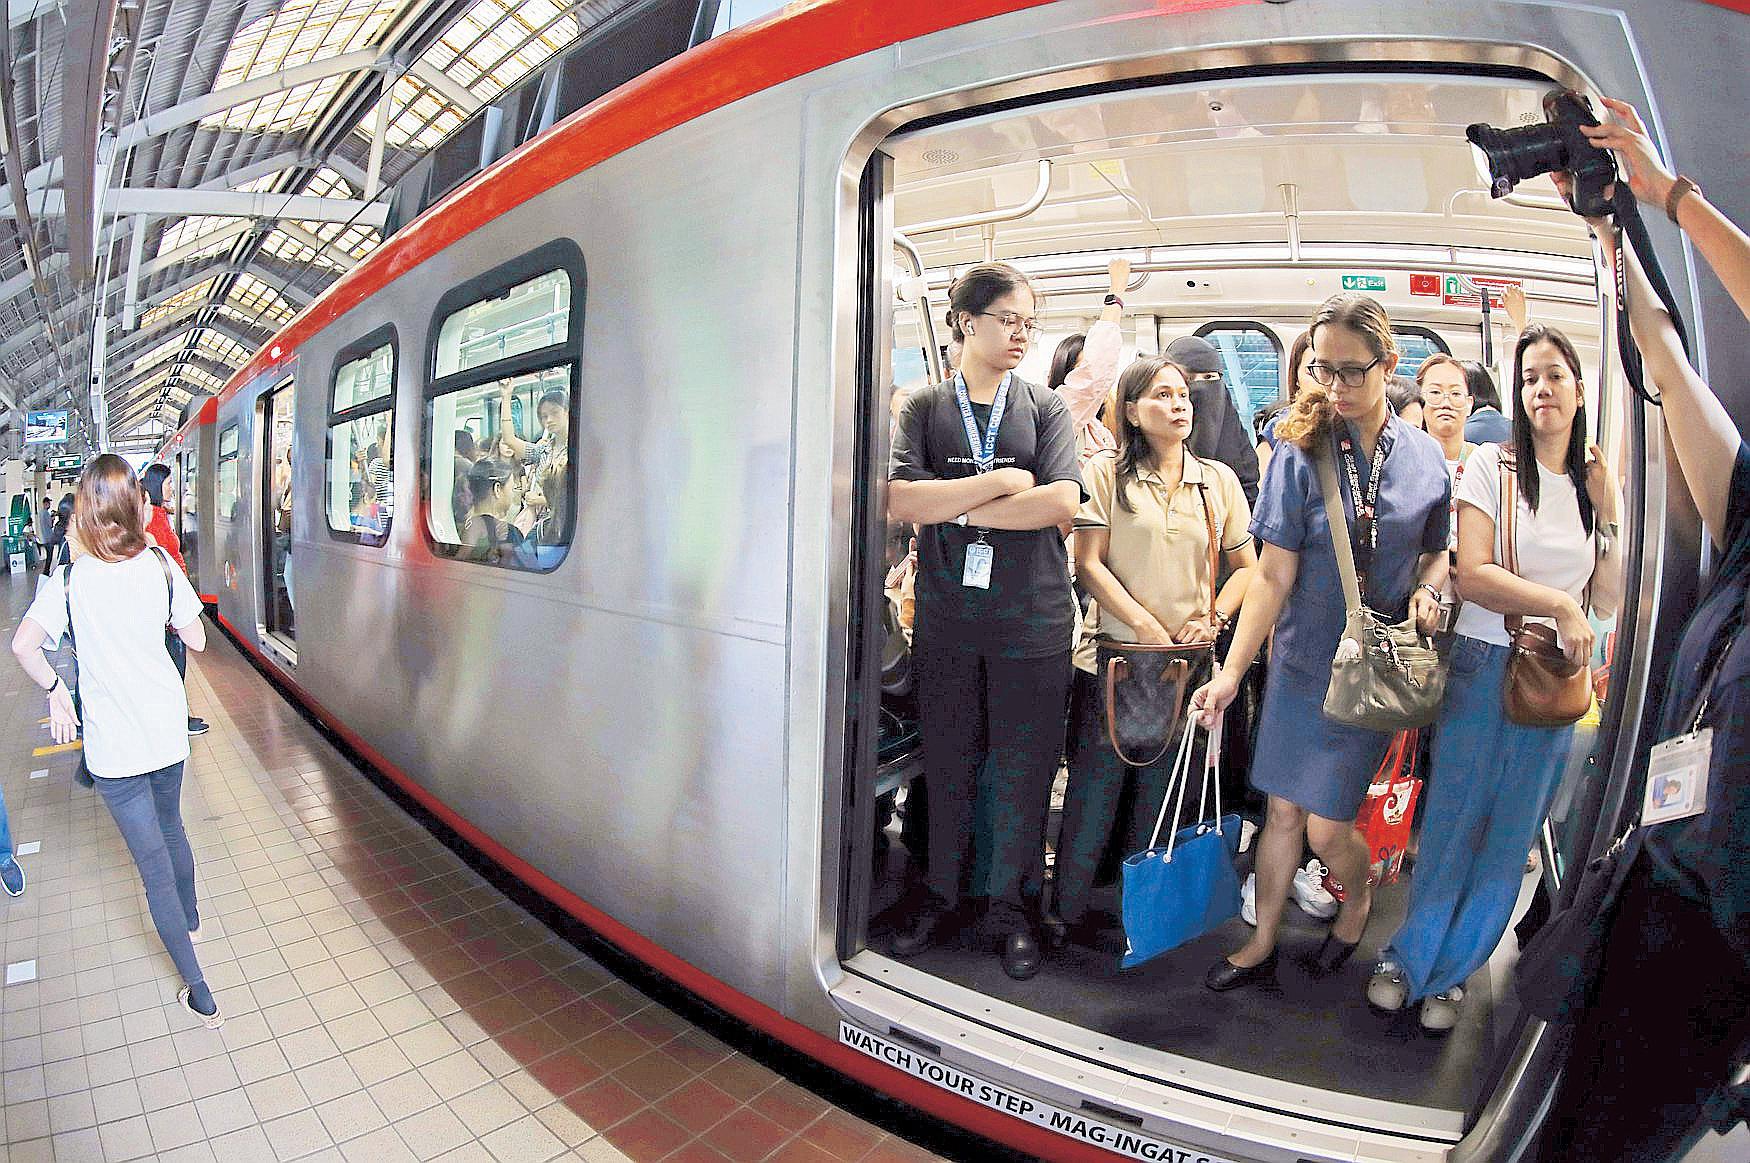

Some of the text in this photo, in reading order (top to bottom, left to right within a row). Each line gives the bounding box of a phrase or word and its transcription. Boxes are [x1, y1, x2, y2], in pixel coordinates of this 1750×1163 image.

[1367, 279, 1385, 287] Exit
[1615, 247, 1625, 311] Canon
[984, 430, 997, 454] ICCT
[843, 1025, 1192, 1163] WATCH YOUR STEP MAG-INGAT
